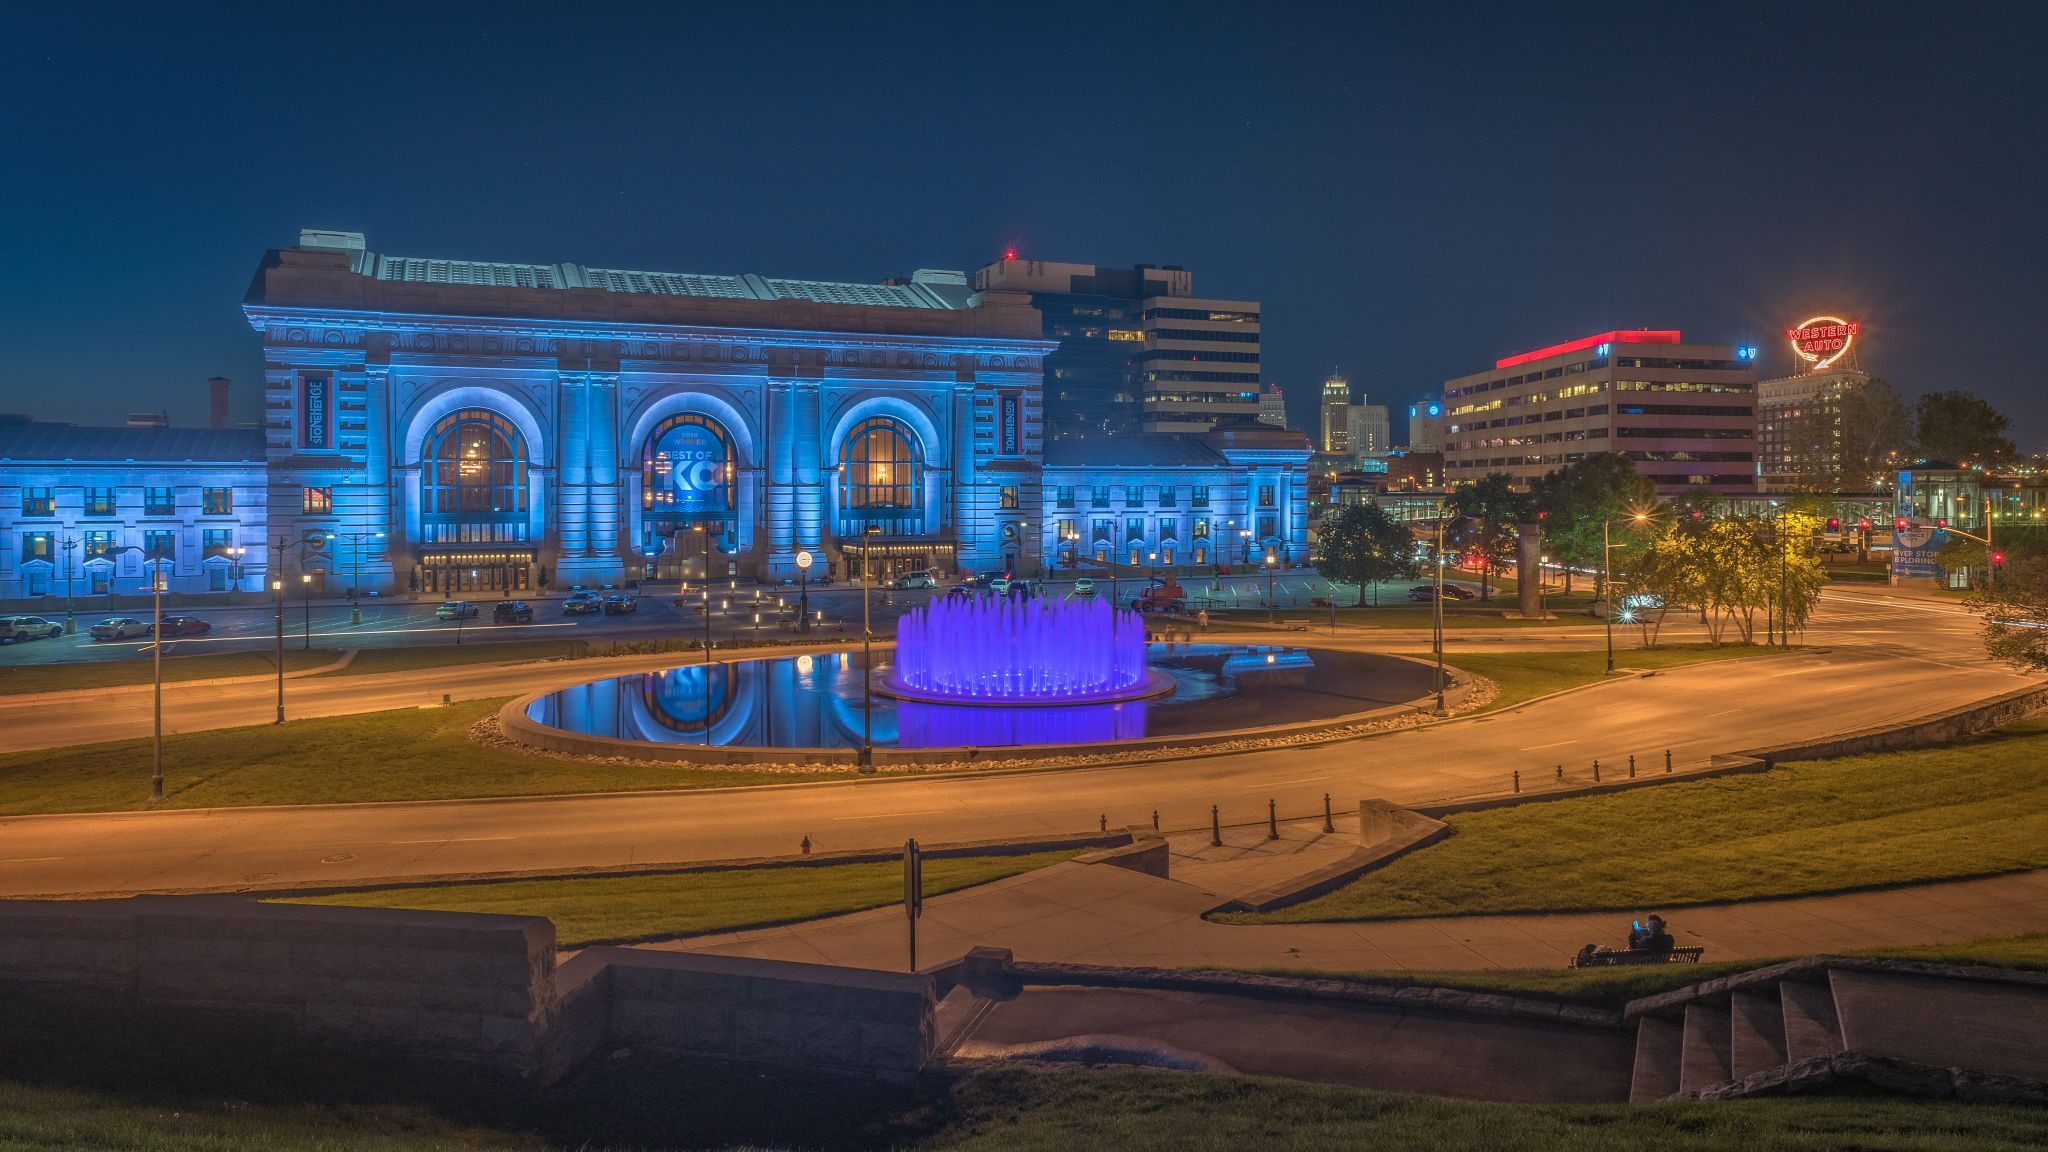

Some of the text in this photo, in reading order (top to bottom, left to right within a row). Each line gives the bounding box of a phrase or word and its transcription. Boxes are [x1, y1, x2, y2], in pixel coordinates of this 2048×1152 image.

[1790, 324, 1857, 340] WESTERN
[1804, 339, 1843, 352] AUTO
[309, 382, 323, 444] STONEHENGE
[1005, 400, 1015, 452] STONEHENGE
[662, 451, 713, 460] BEST OF
[663, 460, 723, 491] KC
